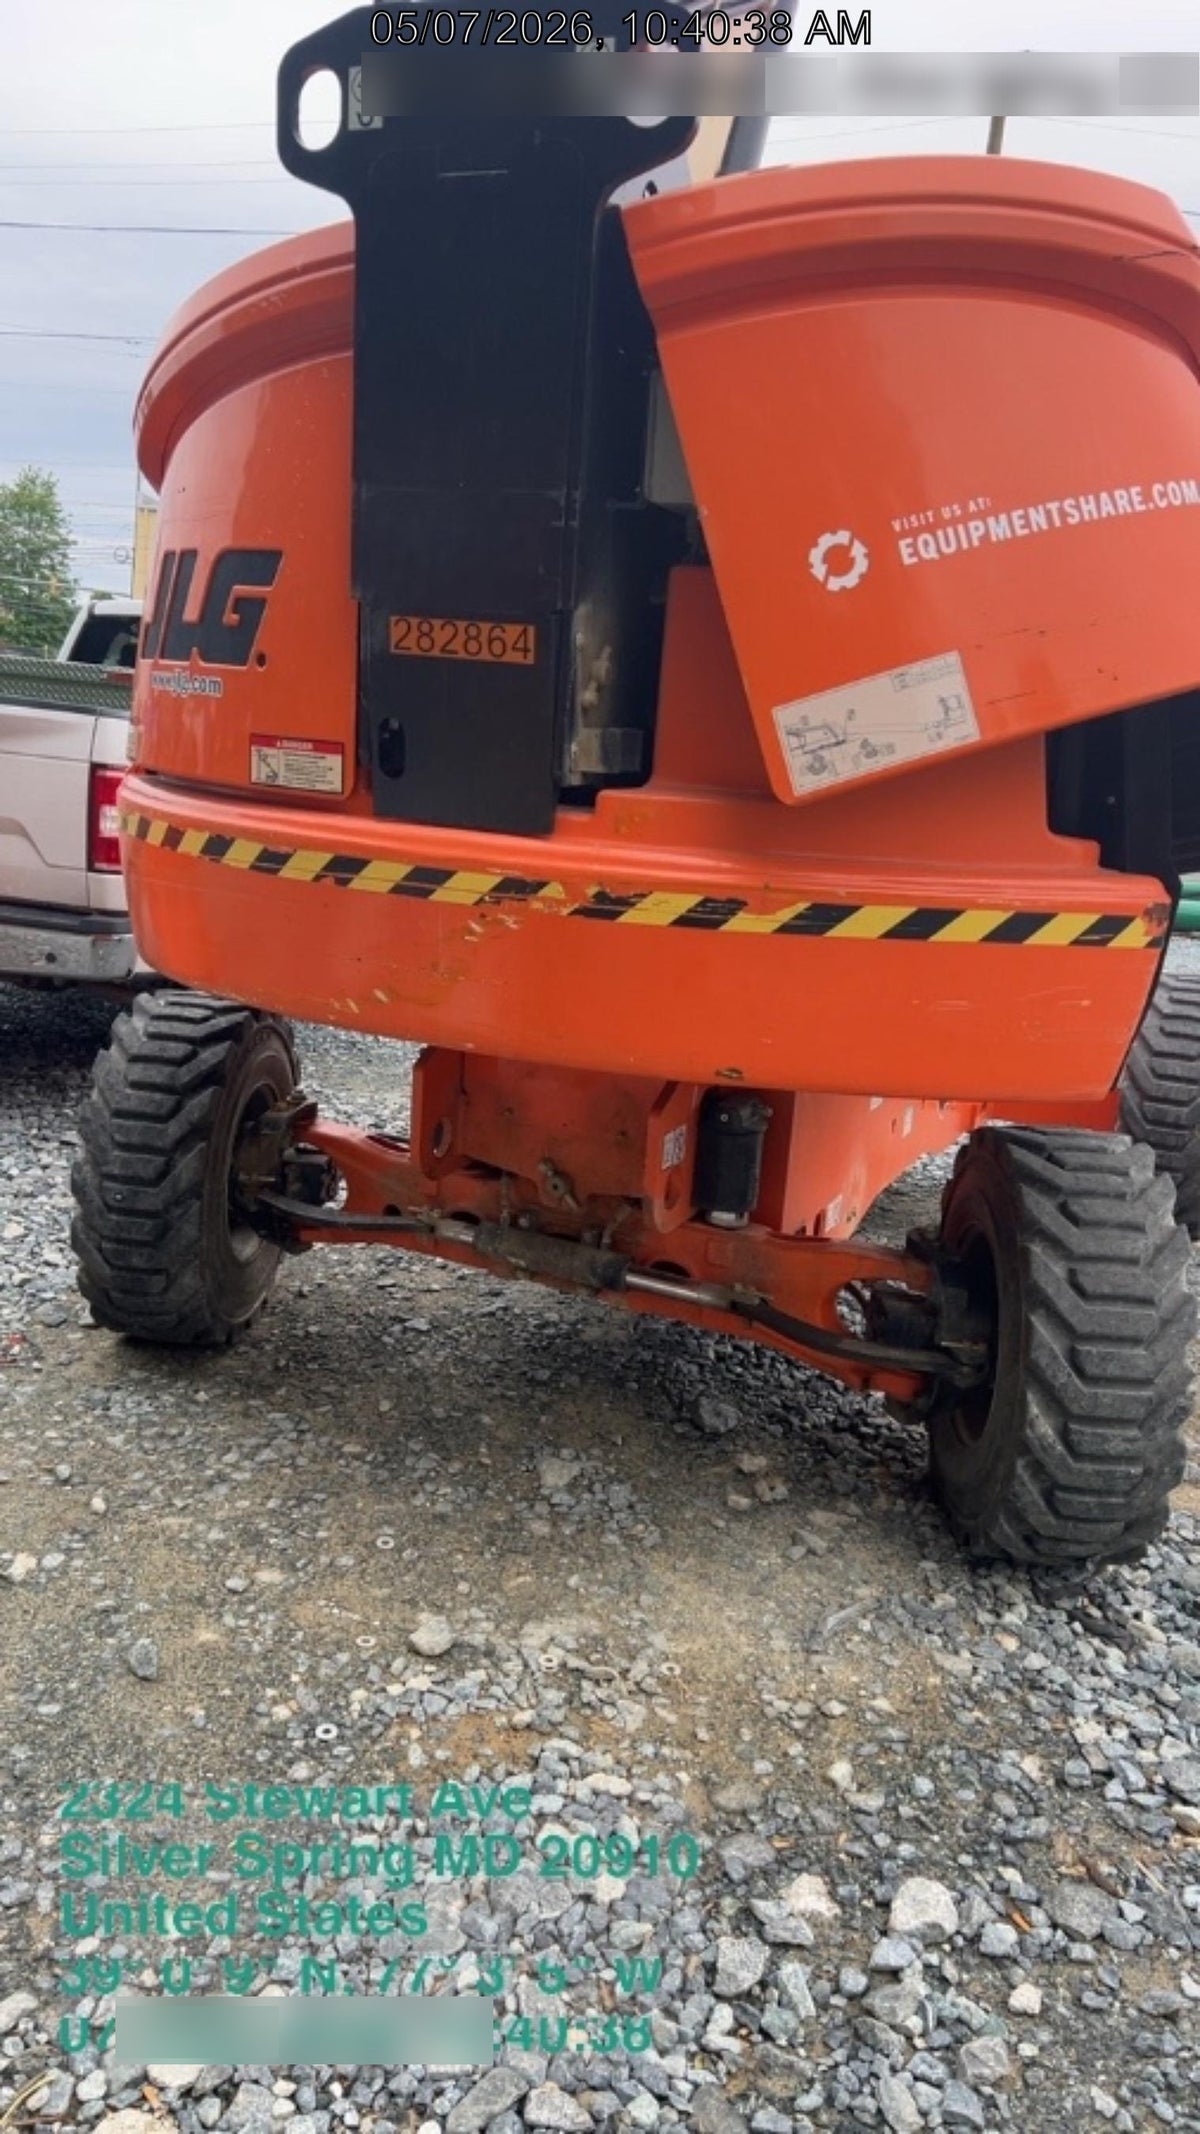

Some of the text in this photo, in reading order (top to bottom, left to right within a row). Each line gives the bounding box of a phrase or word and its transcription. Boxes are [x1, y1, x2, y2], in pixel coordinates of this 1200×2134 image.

[891, 510, 934, 532] VISIT
[941, 503, 962, 521] US
[898, 479, 1200, 566] EQUIPMENTSHARE.COM
[393, 618, 532, 660] 282864
